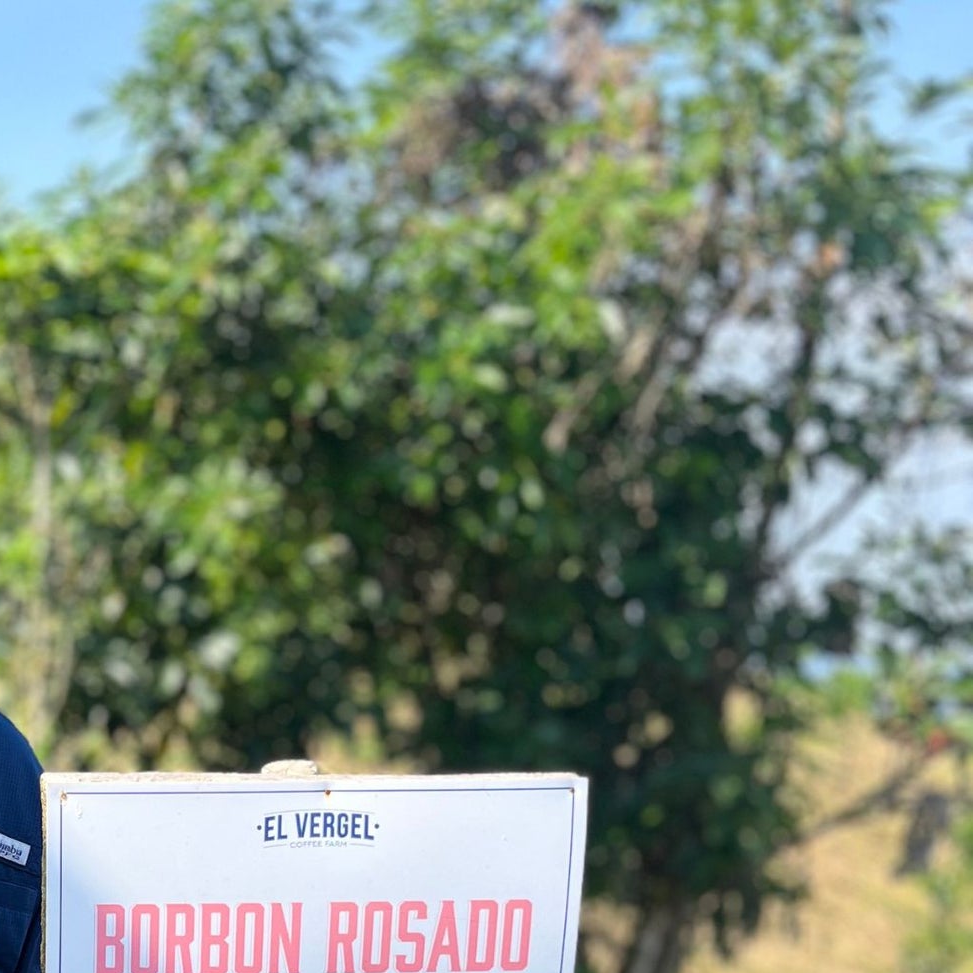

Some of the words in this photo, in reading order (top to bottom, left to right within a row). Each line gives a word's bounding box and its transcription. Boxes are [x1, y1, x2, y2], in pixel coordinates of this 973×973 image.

[264, 815, 287, 841] EL
[295, 812, 374, 840] VERGEL
[290, 840, 323, 848] COFFEE
[325, 840, 347, 848] FARM
[327, 899, 532, 973] ROSADO
